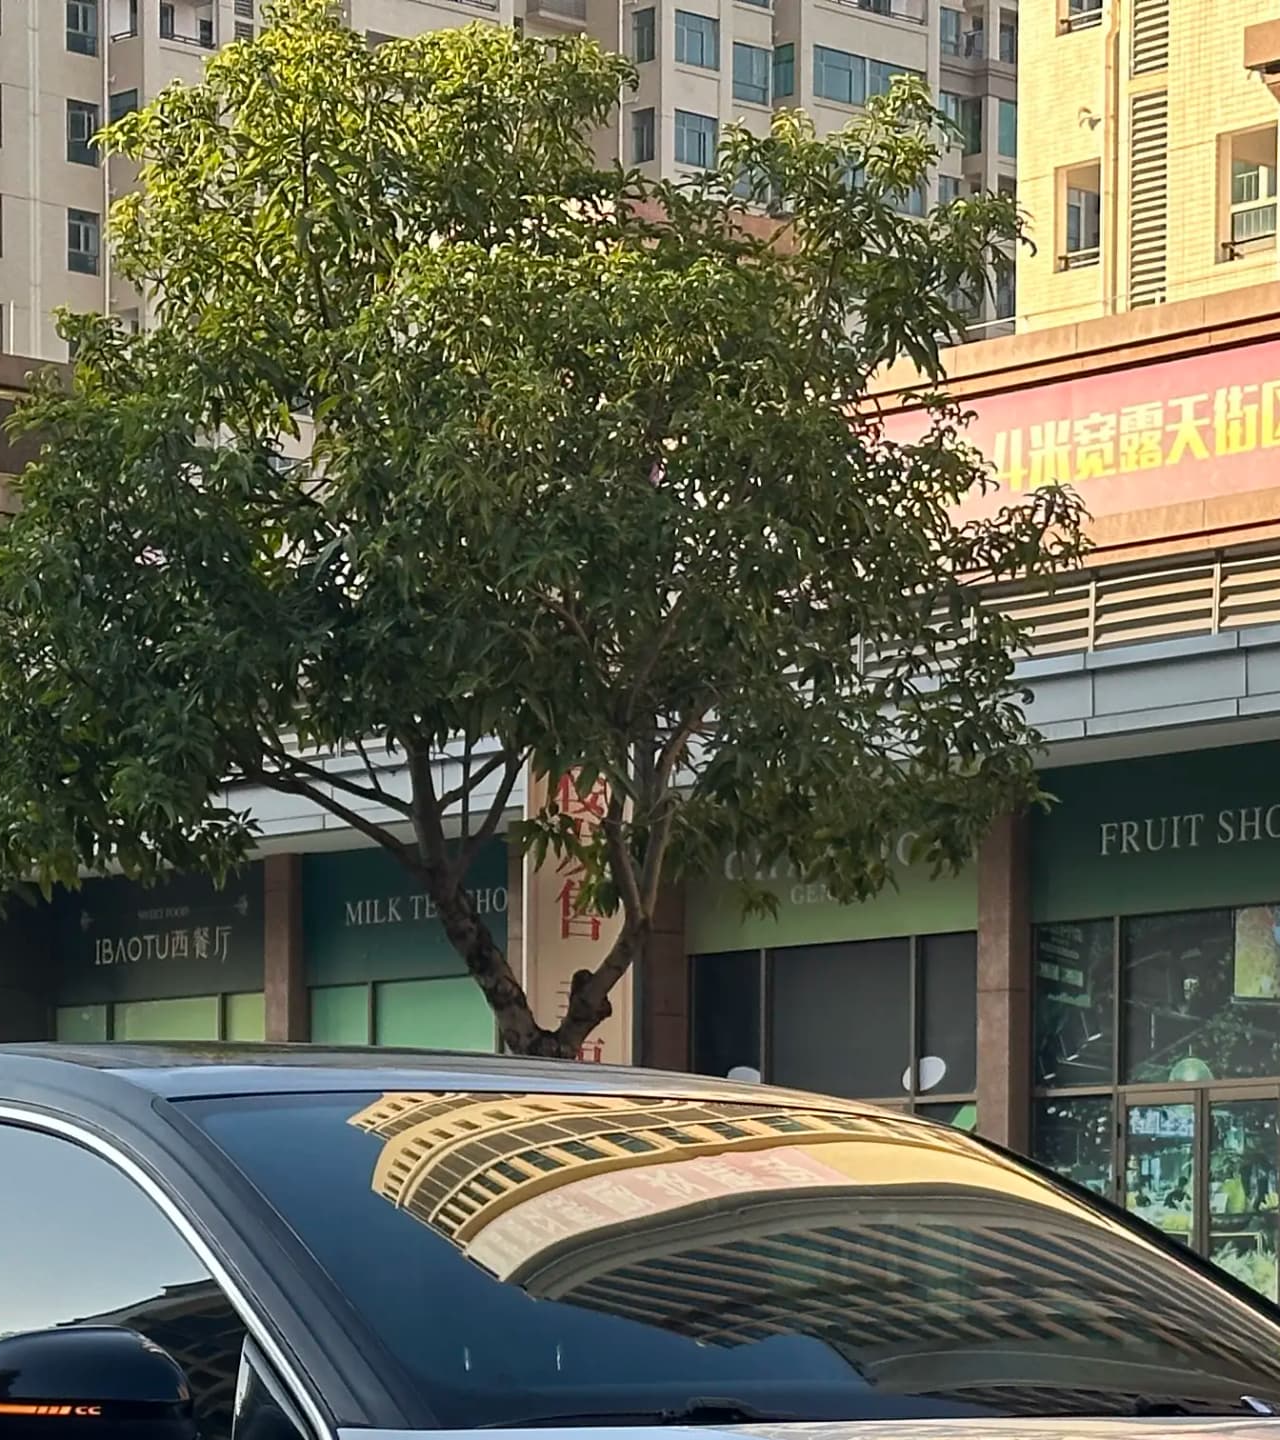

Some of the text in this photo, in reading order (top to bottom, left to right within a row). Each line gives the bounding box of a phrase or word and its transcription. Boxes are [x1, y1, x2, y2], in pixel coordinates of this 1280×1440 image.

[1100, 813, 1204, 856] FRUIT
[345, 896, 402, 927] MILK
[409, 893, 439, 920] TE
